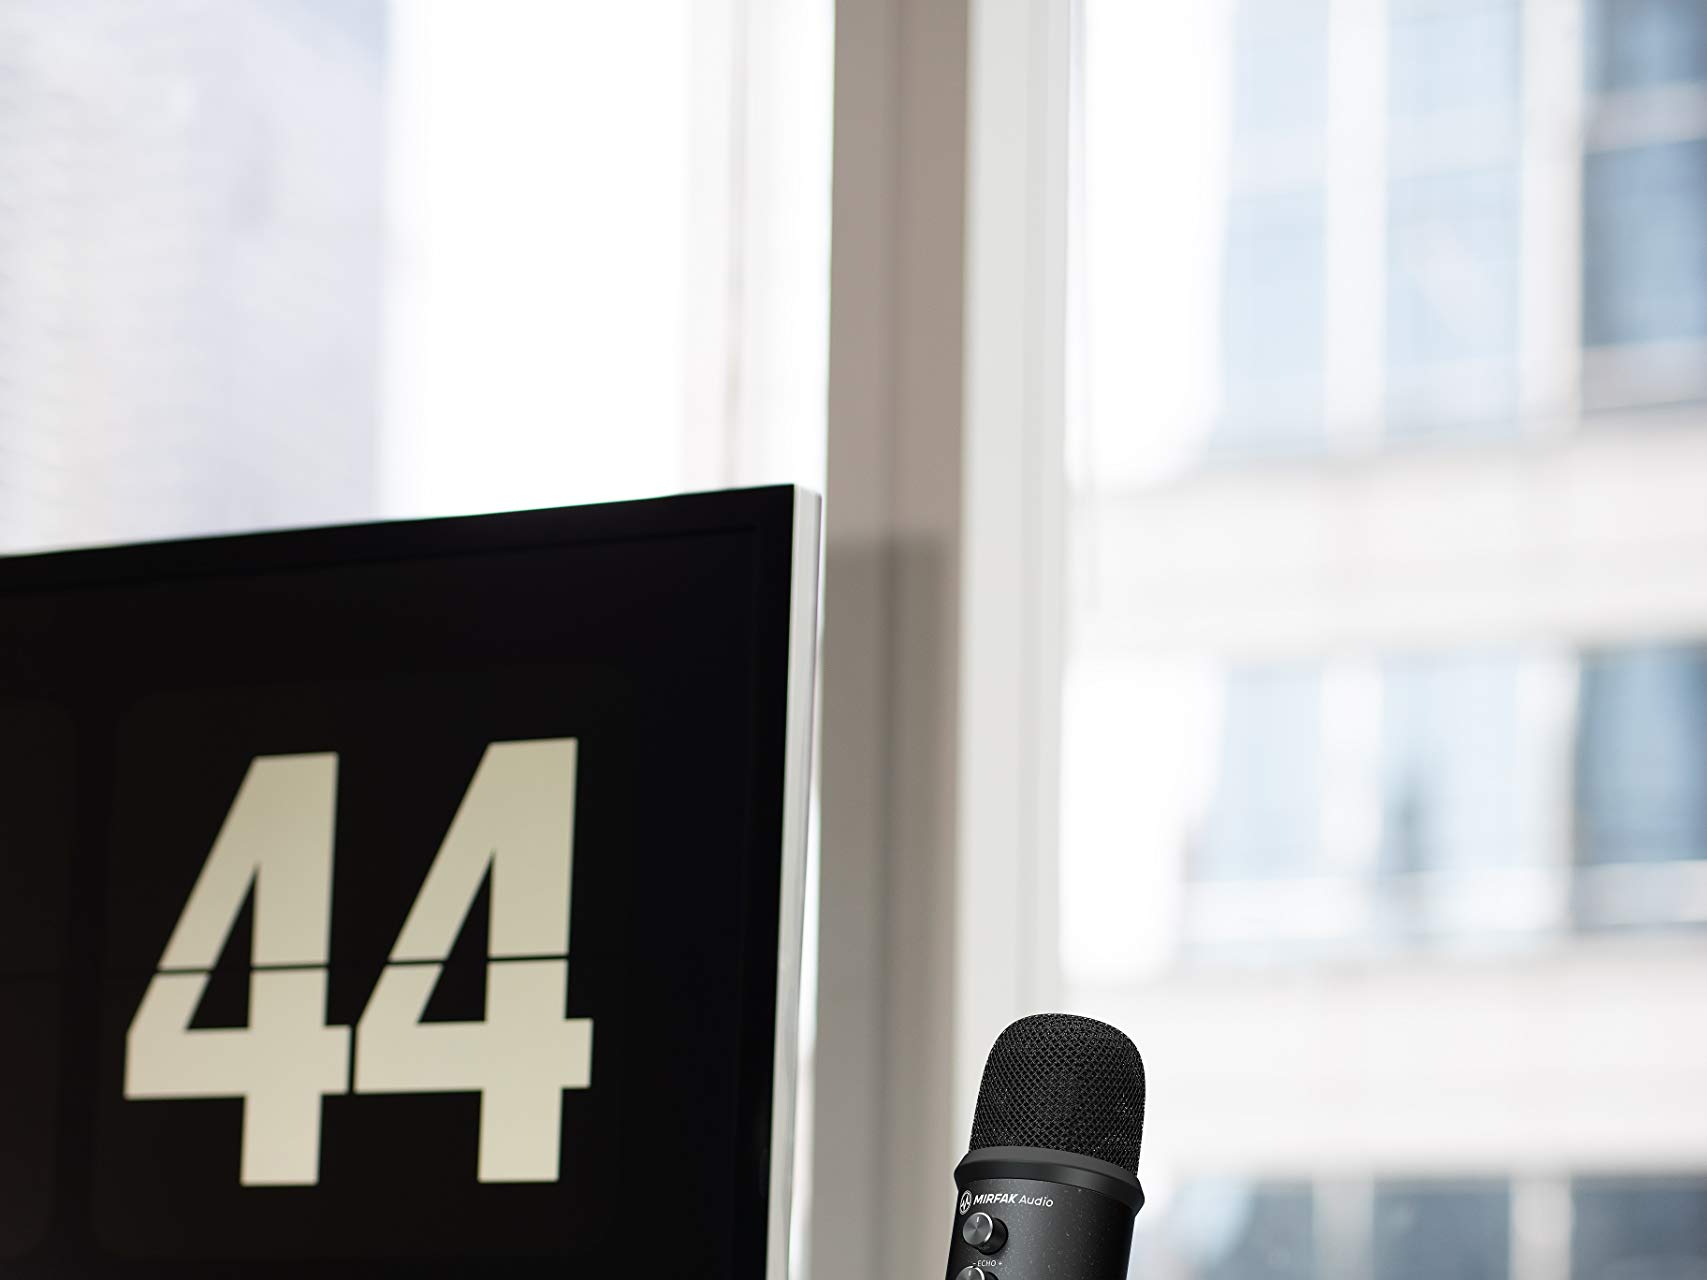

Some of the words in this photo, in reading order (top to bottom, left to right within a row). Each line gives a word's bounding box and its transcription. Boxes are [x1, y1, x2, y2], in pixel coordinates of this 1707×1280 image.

[124, 736, 594, 1187] 44
[973, 1193, 1018, 1206] MIRFAK
[1018, 1194, 1054, 1208] Audio
